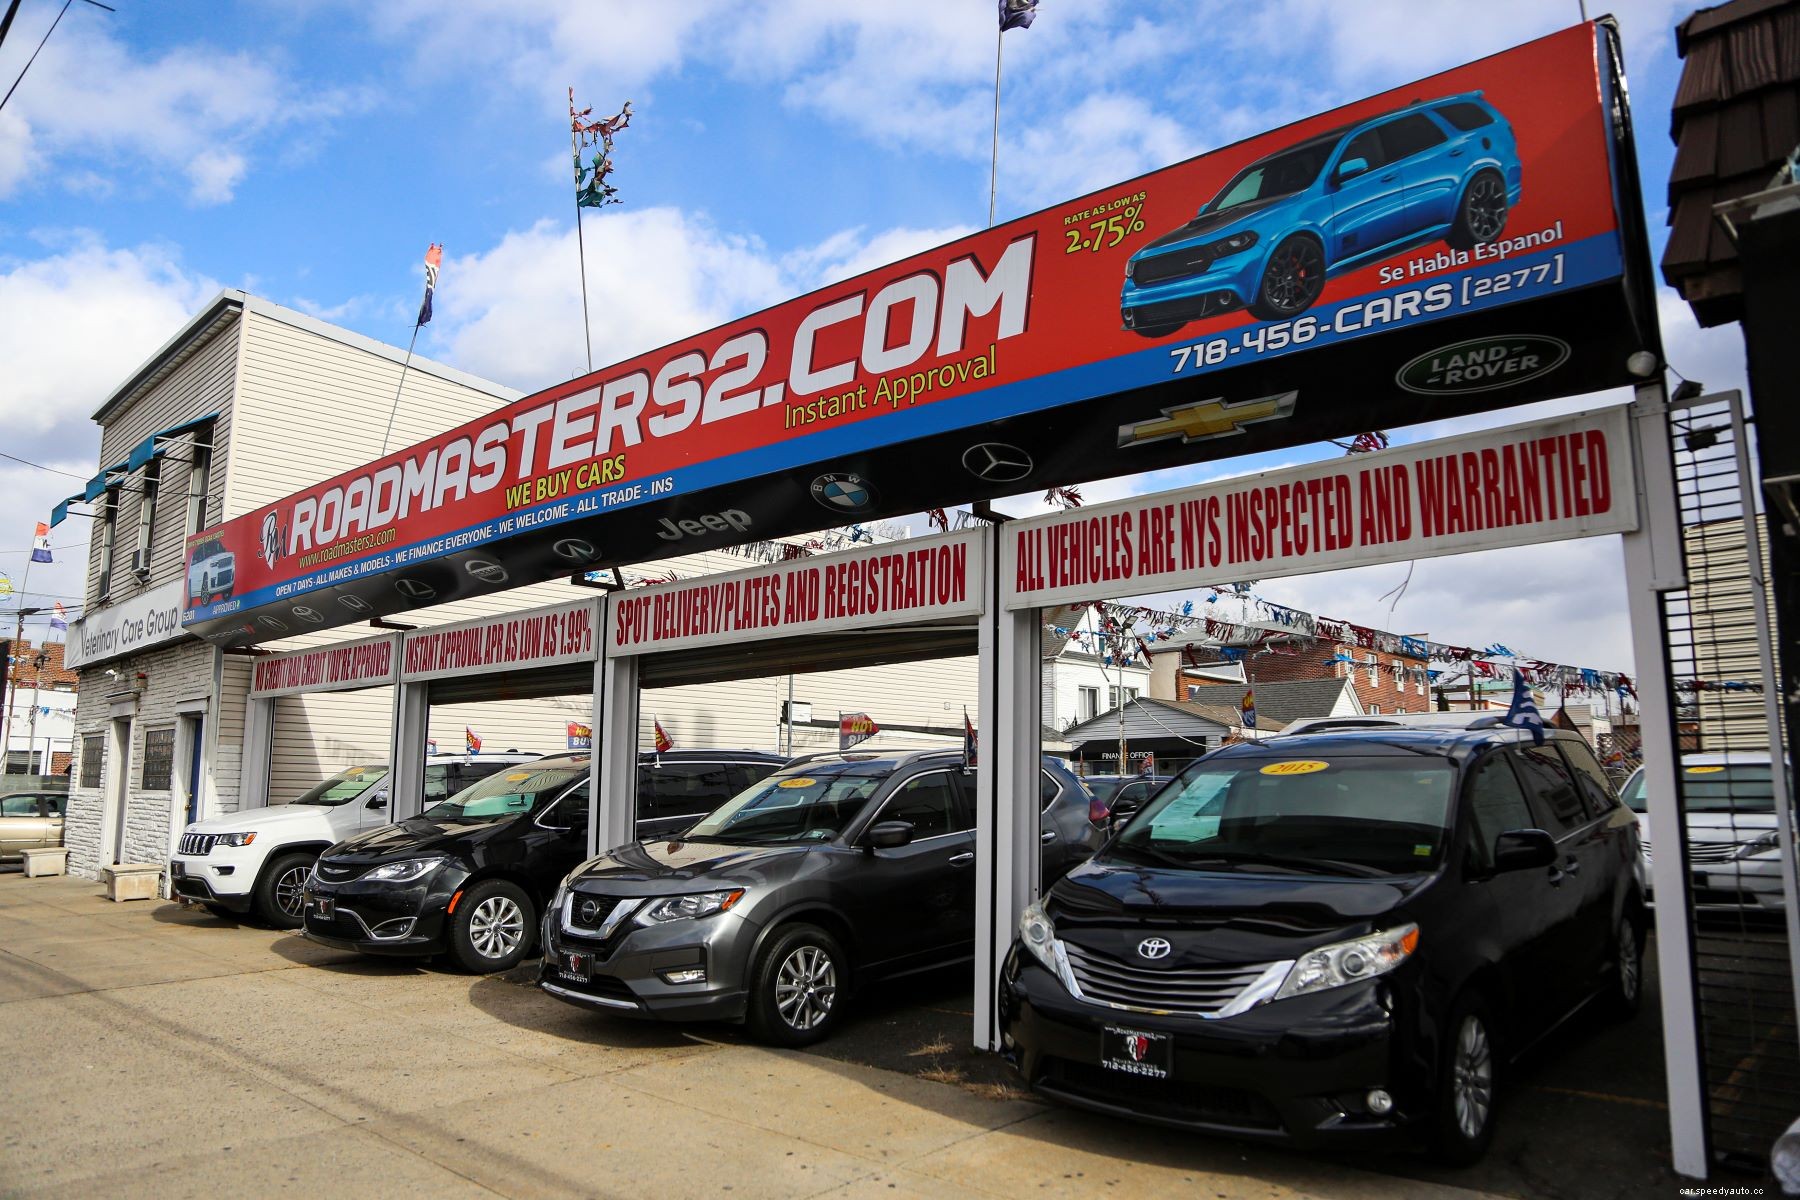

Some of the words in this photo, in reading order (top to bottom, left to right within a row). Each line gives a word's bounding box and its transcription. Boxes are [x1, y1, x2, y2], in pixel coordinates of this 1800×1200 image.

[1064, 210, 1091, 225] RATE
[1092, 205, 1106, 216] AS
[1108, 197, 1130, 211] LOW
[1132, 191, 1146, 203] AS
[1066, 203, 1145, 254] 2.75%
[1379, 266, 1404, 285] Se
[1409, 249, 1470, 277] Habla
[1474, 220, 1564, 259] Espanol
[1170, 283, 1453, 373] 718-456-CARS
[1461, 254, 1565, 306] [2277]
[1431, 345, 1508, 373] LAND
[1444, 354, 1540, 385] ROVER
[289, 231, 1038, 556] ROADMASTERS2.COM
[785, 386, 869, 429] Instant
[873, 344, 997, 410] Approval
[505, 481, 532, 511] WE
[536, 469, 572, 502] BUY
[576, 454, 626, 491] CARS
[656, 508, 753, 541] Jeep
[1016, 530, 1045, 593] ALL
[1048, 517, 1134, 587] VEHICLES
[1138, 502, 1175, 576] ARE
[1181, 495, 1222, 570] NYS
[1227, 474, 1353, 564] INSPECTED
[1360, 464, 1412, 547] AND
[1415, 429, 1612, 538] WARRANTIED
[275, 583, 292, 597] OPEN
[293, 582, 297, 592] 7
[297, 578, 313, 591] DAYS
[316, 573, 328, 585] ALL
[329, 566, 353, 582] MAKES
[354, 563, 360, 575] &
[360, 555, 390, 573] MODELS
[395, 551, 408, 564] WE
[408, 540, 444, 560] FINANCE
[445, 525, 493, 550] EVERYONE
[499, 518, 514, 534] WE
[516, 503, 569, 529] WELCOME
[576, 497, 599, 514] ALL
[602, 485, 642, 507] TRADE
[651, 477, 674, 496] INS
[299, 528, 396, 569] www.roadmasters2.com
[616, 595, 651, 647] SPOT
[653, 573, 781, 641] DELIVERY/PLATES
[784, 567, 820, 625] AND
[824, 543, 967, 619] REGISTRATION
[81, 626, 120, 659] Veterinary
[122, 618, 144, 645] Care
[146, 606, 178, 636] Group
[404, 633, 440, 674] INSTANT
[438, 626, 484, 670] APPROVAL
[484, 623, 504, 665] APR
[504, 620, 519, 662] AS
[520, 616, 543, 661] LOW
[543, 613, 558, 657] AS
[560, 607, 592, 655] 1.99%
[255, 661, 265, 691] NO
[301, 651, 327, 687] CREDIT
[326, 647, 352, 683] YOU'RE
[351, 640, 391, 680] APPROVED
[575, 726, 592, 737] HO
[848, 734, 869, 746] BU
[852, 720, 873, 733] HOT
[1102, 752, 1129, 760] FINANE
[1271, 762, 1320, 773] 2015
[1102, 1060, 1167, 1079] 718-456-2277
